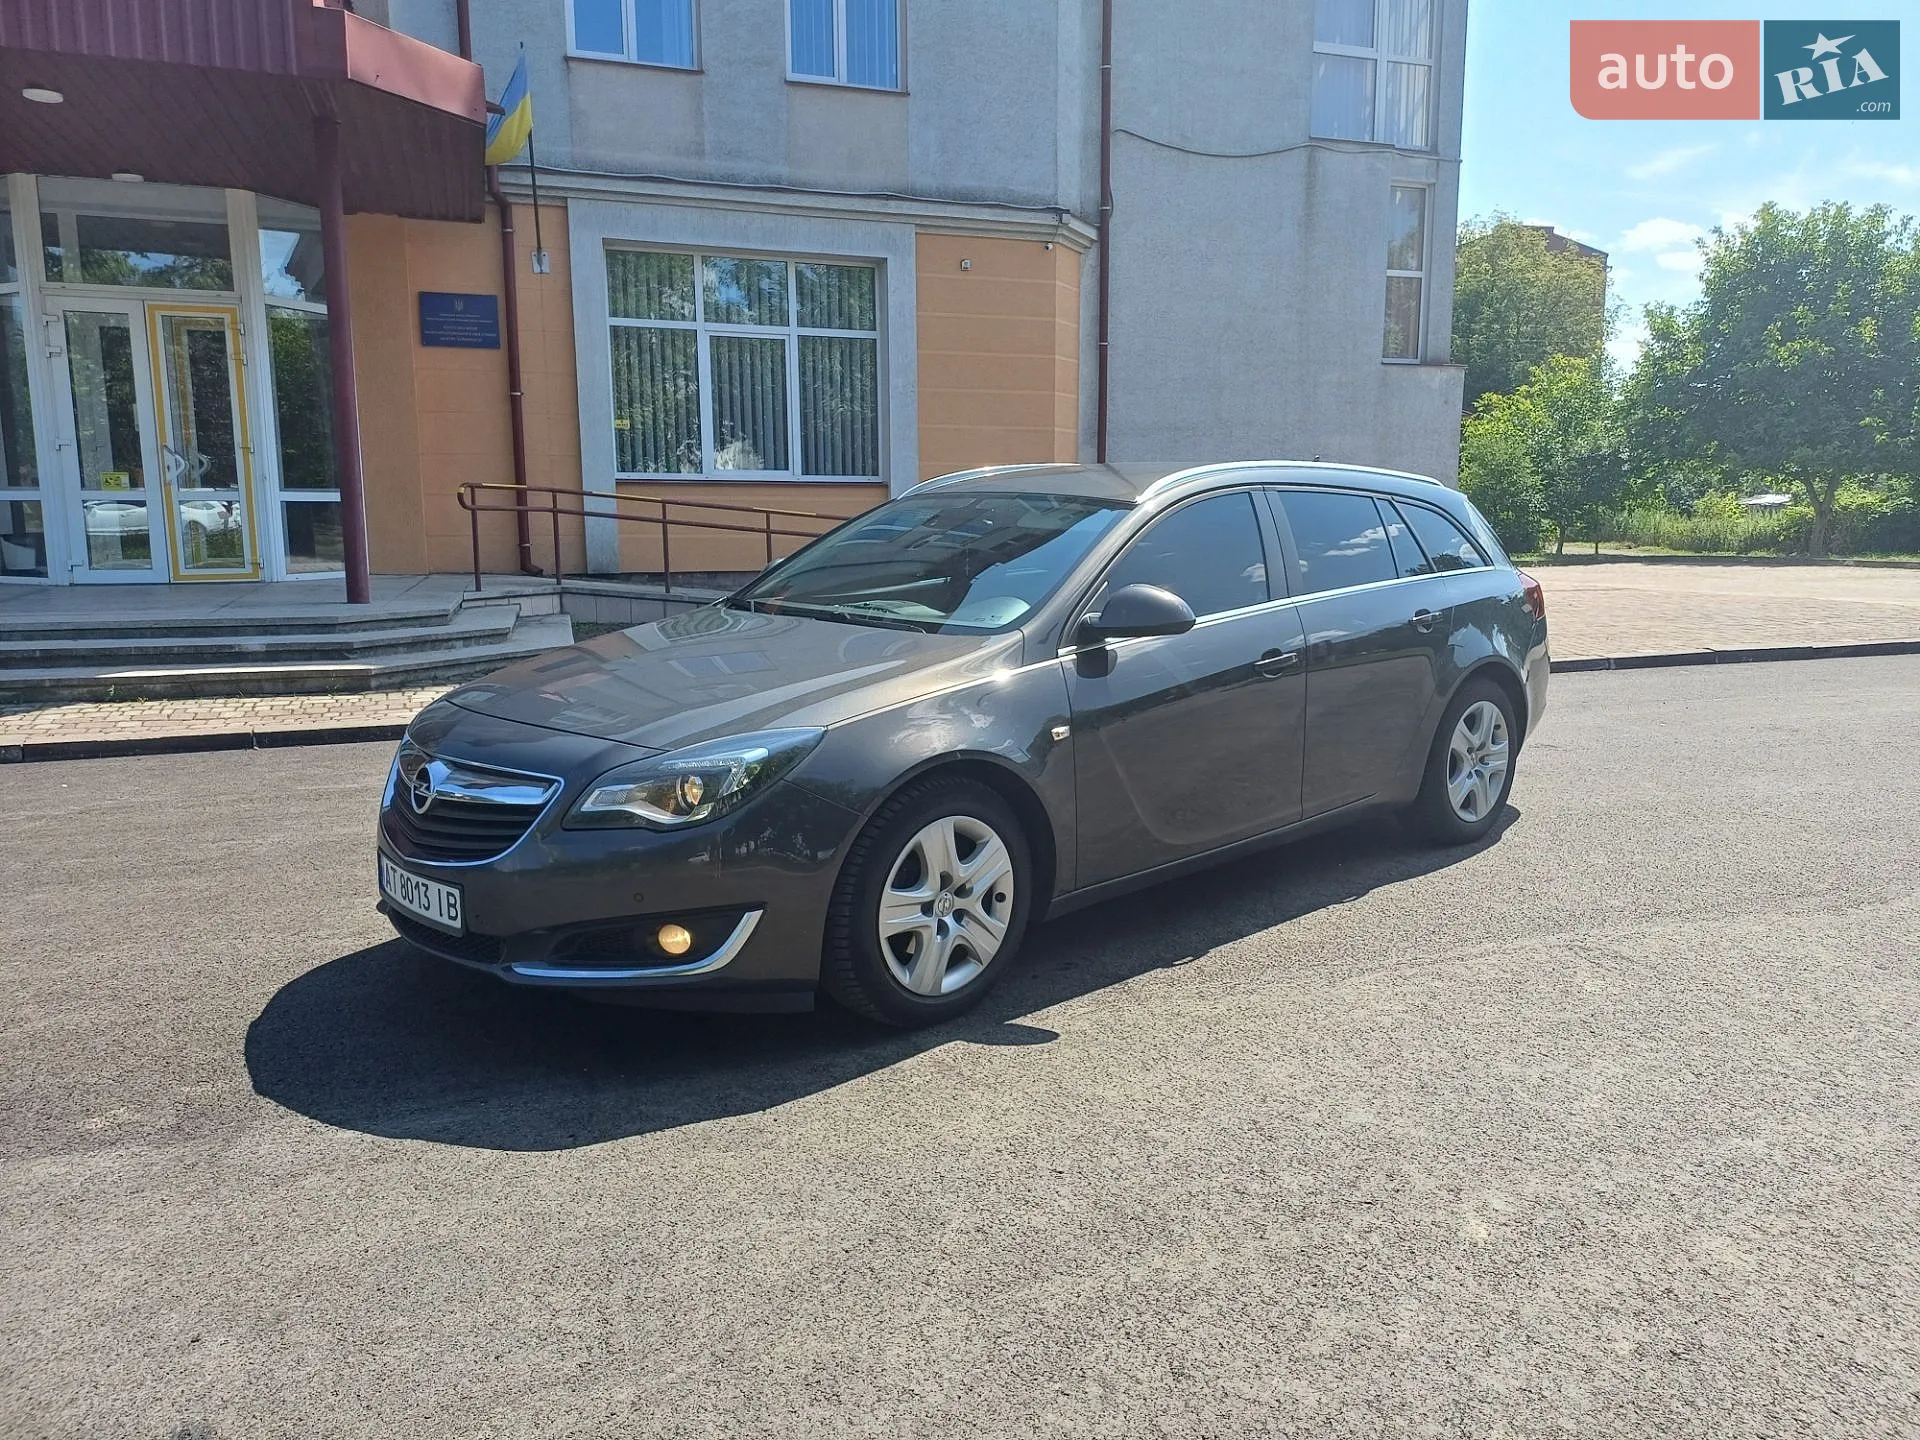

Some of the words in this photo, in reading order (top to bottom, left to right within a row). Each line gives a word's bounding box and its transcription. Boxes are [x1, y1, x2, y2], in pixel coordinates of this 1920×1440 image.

[385, 863, 397, 895] AT
[400, 872, 431, 911] 8013
[437, 888, 459, 921] IB
